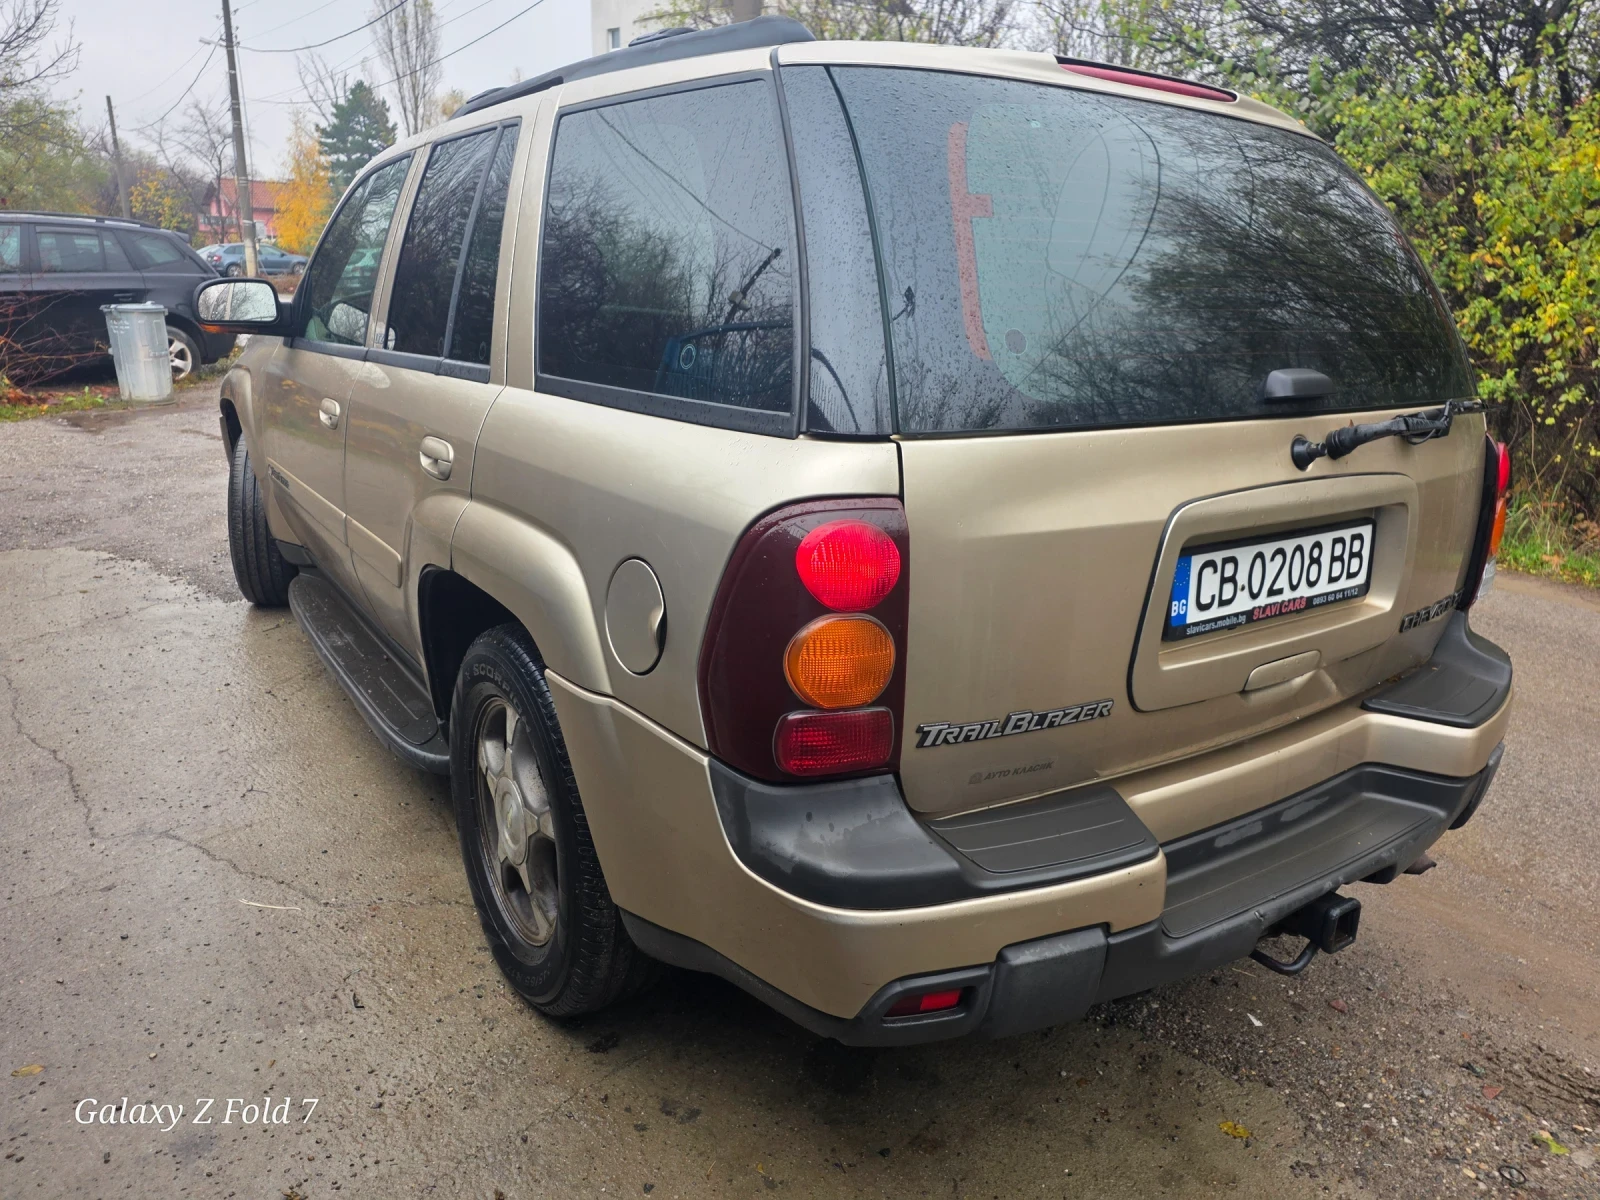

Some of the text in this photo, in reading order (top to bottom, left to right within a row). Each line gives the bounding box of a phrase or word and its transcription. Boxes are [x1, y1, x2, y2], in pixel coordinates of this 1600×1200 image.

[1248, 540, 1323, 600] 0208
[1171, 600, 1187, 617] BG
[1252, 596, 1307, 620] SLAVI CARS
[1186, 614, 1247, 635] slavicars.mobile.bg
